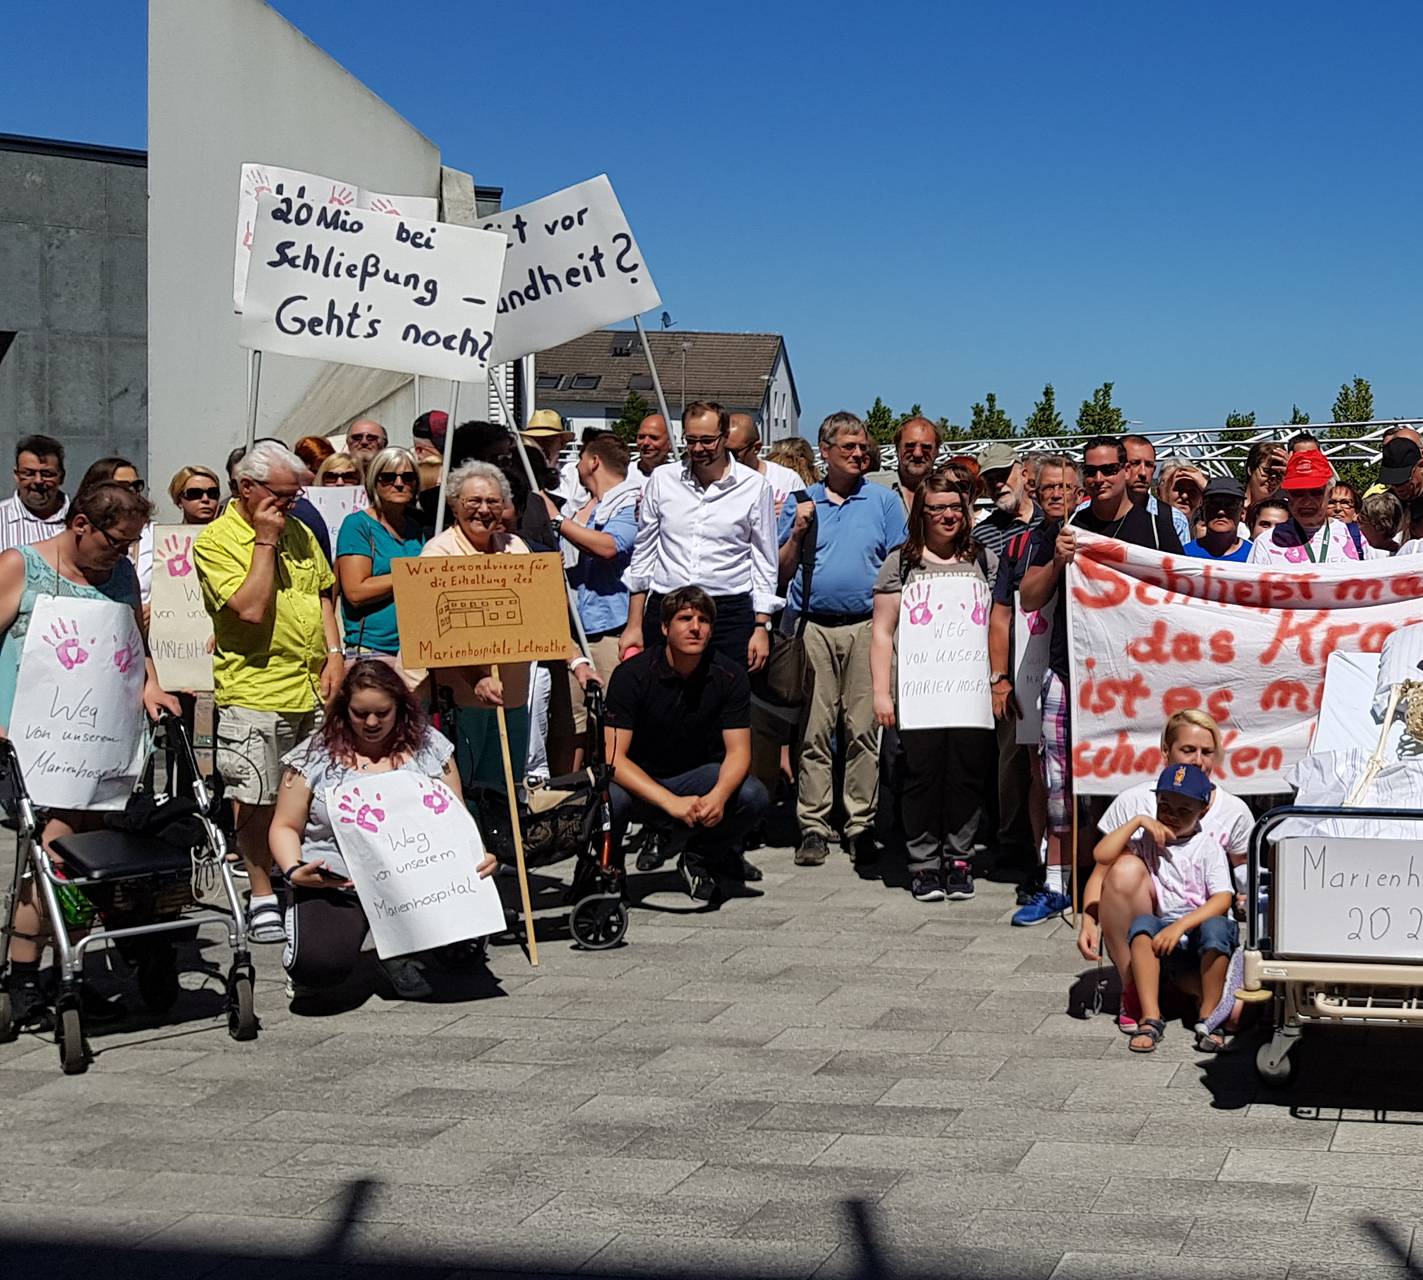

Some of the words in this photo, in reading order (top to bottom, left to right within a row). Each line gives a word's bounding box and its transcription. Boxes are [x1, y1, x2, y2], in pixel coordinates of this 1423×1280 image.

[396, 221, 436, 250] bei
[544, 207, 588, 235] vor
[267, 240, 438, 306] Schließung
[496, 233, 639, 314] undheit?
[275, 295, 382, 340] Geht's
[402, 323, 493, 368] noch?
[406, 562, 434, 576] Wir
[529, 558, 550, 576] für
[430, 576, 446, 588] die
[187, 609, 209, 619] uns
[933, 621, 968, 639] WEG
[1125, 620, 1236, 664] das
[935, 648, 988, 664] UNSERE
[1078, 657, 1151, 718] ist
[50, 685, 98, 729] Weg
[388, 827, 431, 854] Weg
[372, 870, 391, 882] von
[396, 849, 456, 874] unserem
[373, 876, 477, 920] Marienhospital
